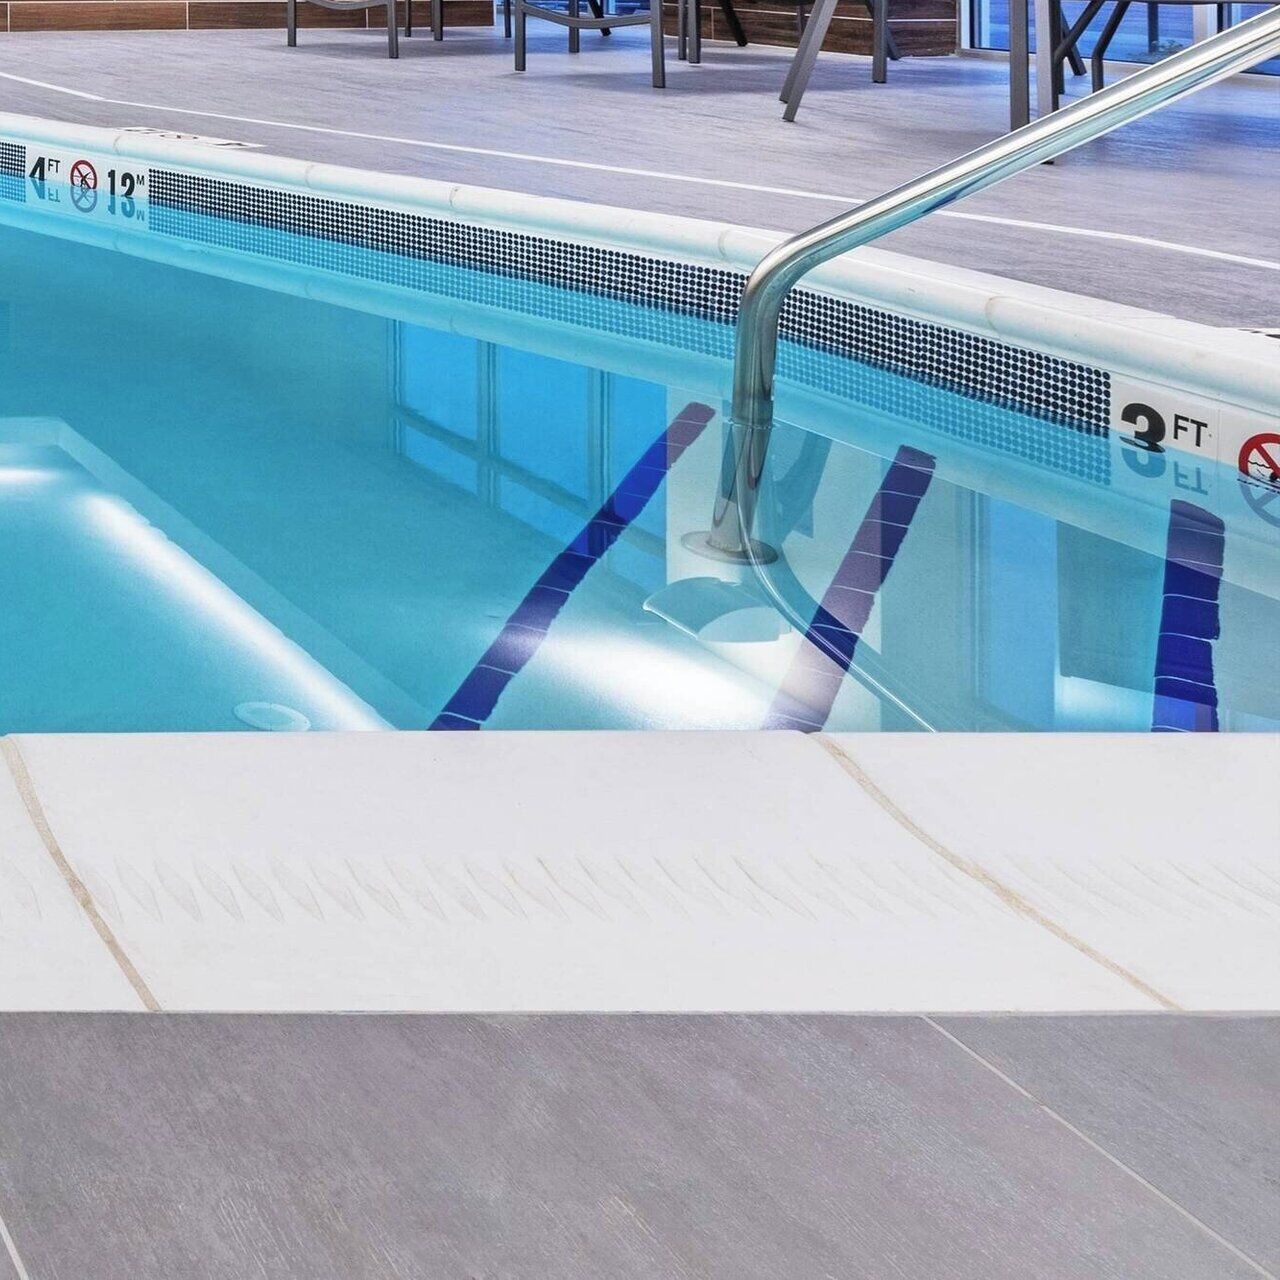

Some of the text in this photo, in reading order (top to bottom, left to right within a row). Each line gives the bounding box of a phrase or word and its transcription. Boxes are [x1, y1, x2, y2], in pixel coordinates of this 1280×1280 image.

[48, 159, 61, 173] FT
[136, 174, 145, 186] M
[1119, 403, 1208, 453] 3 FT
